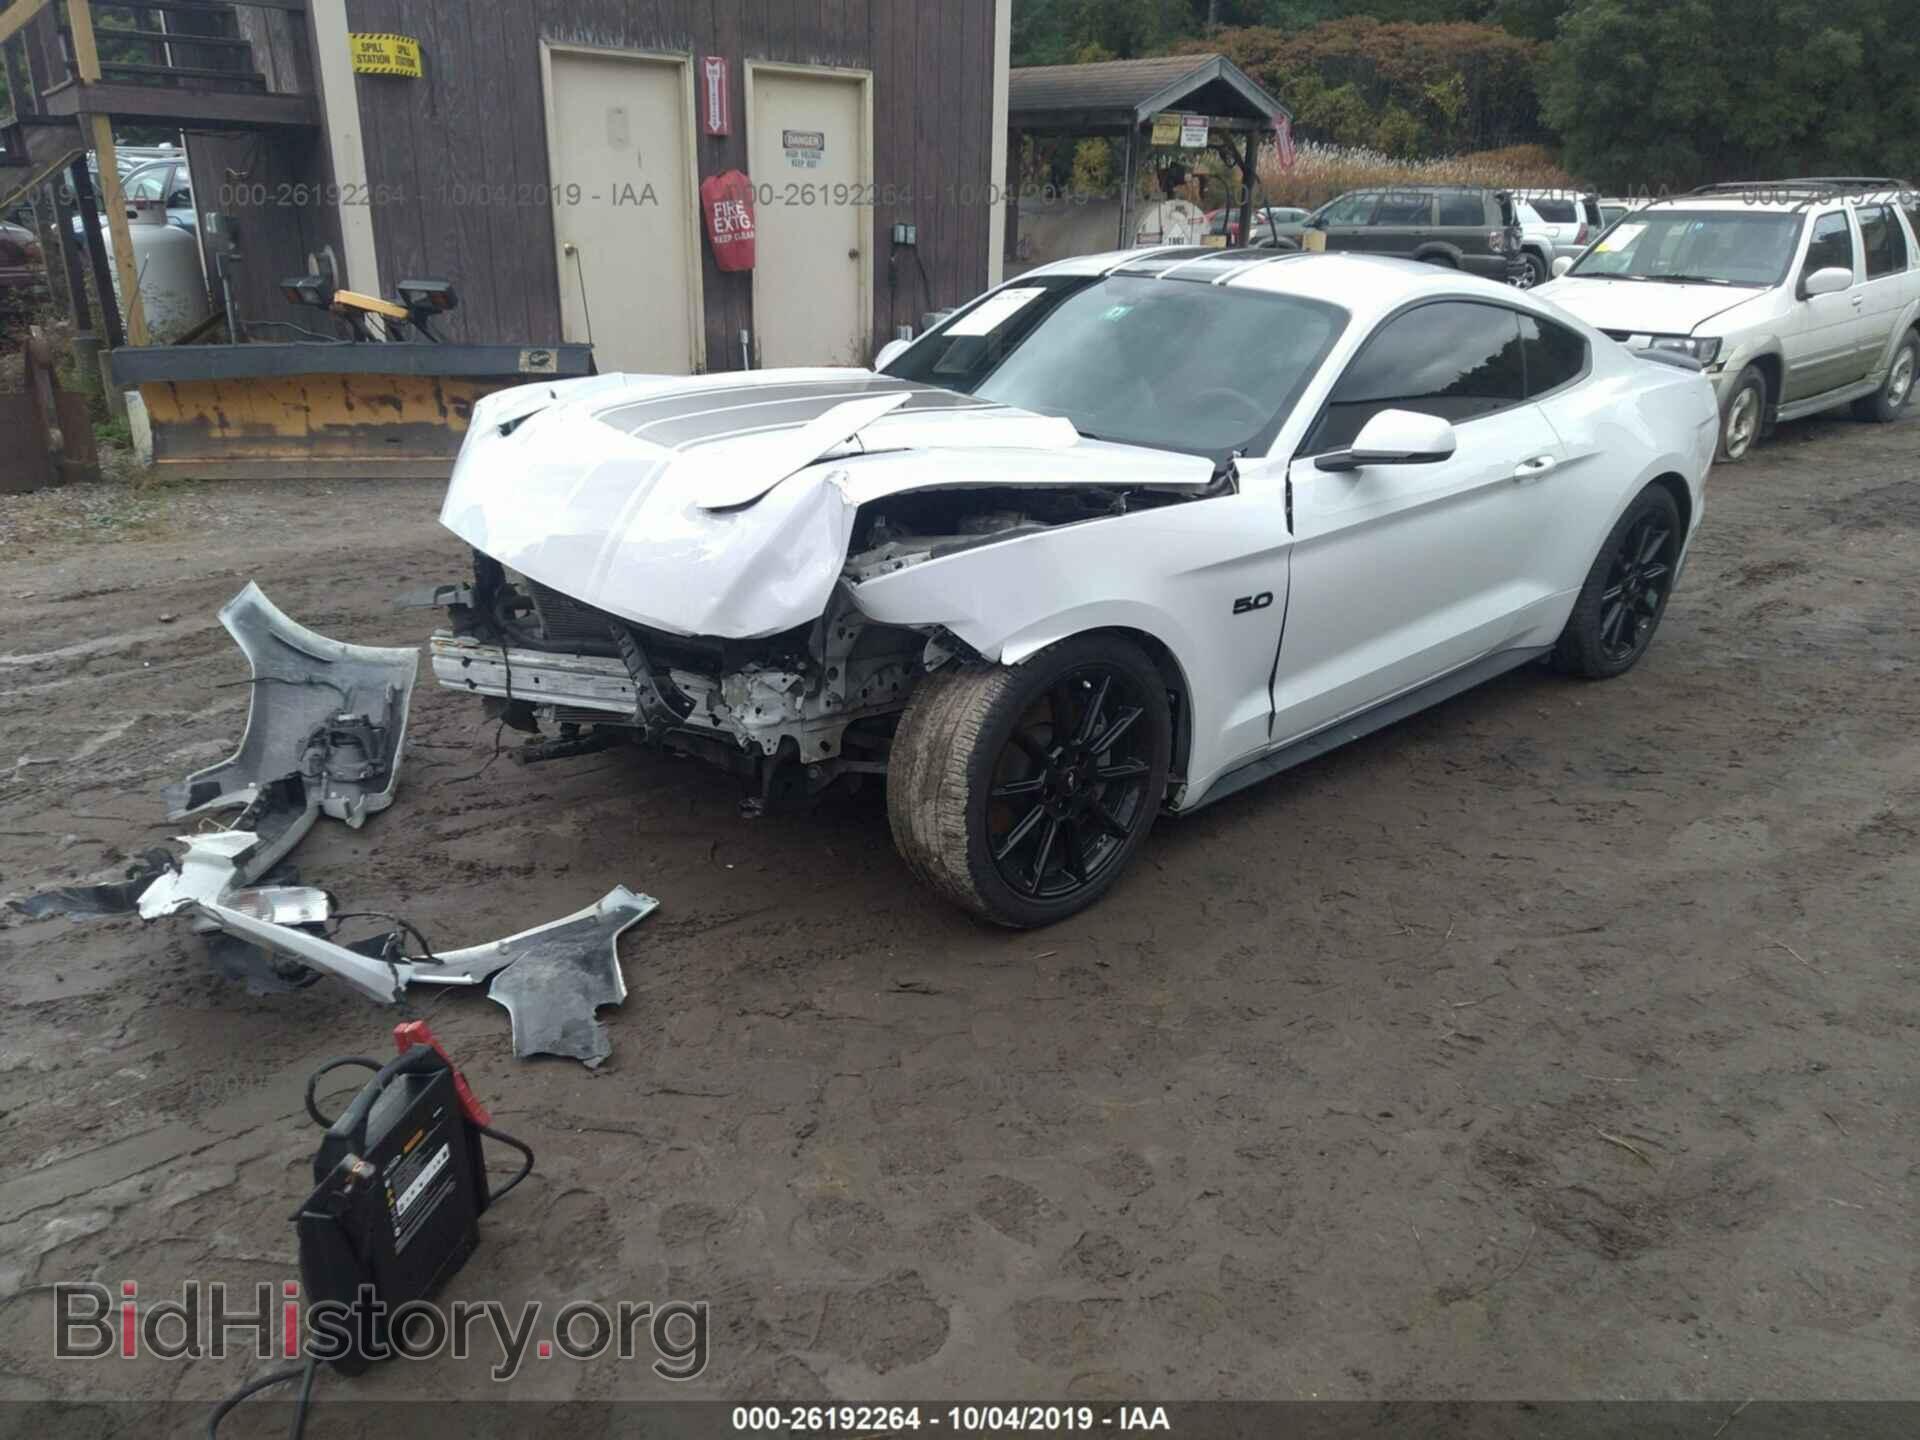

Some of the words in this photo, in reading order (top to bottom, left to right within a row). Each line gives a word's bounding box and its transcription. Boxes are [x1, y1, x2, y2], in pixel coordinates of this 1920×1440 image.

[361, 42, 385, 53] SPILL
[357, 54, 391, 66] STATION
[788, 135, 819, 146] DANGER
[714, 200, 745, 217] FIRE
[714, 214, 754, 233] EXTG.
